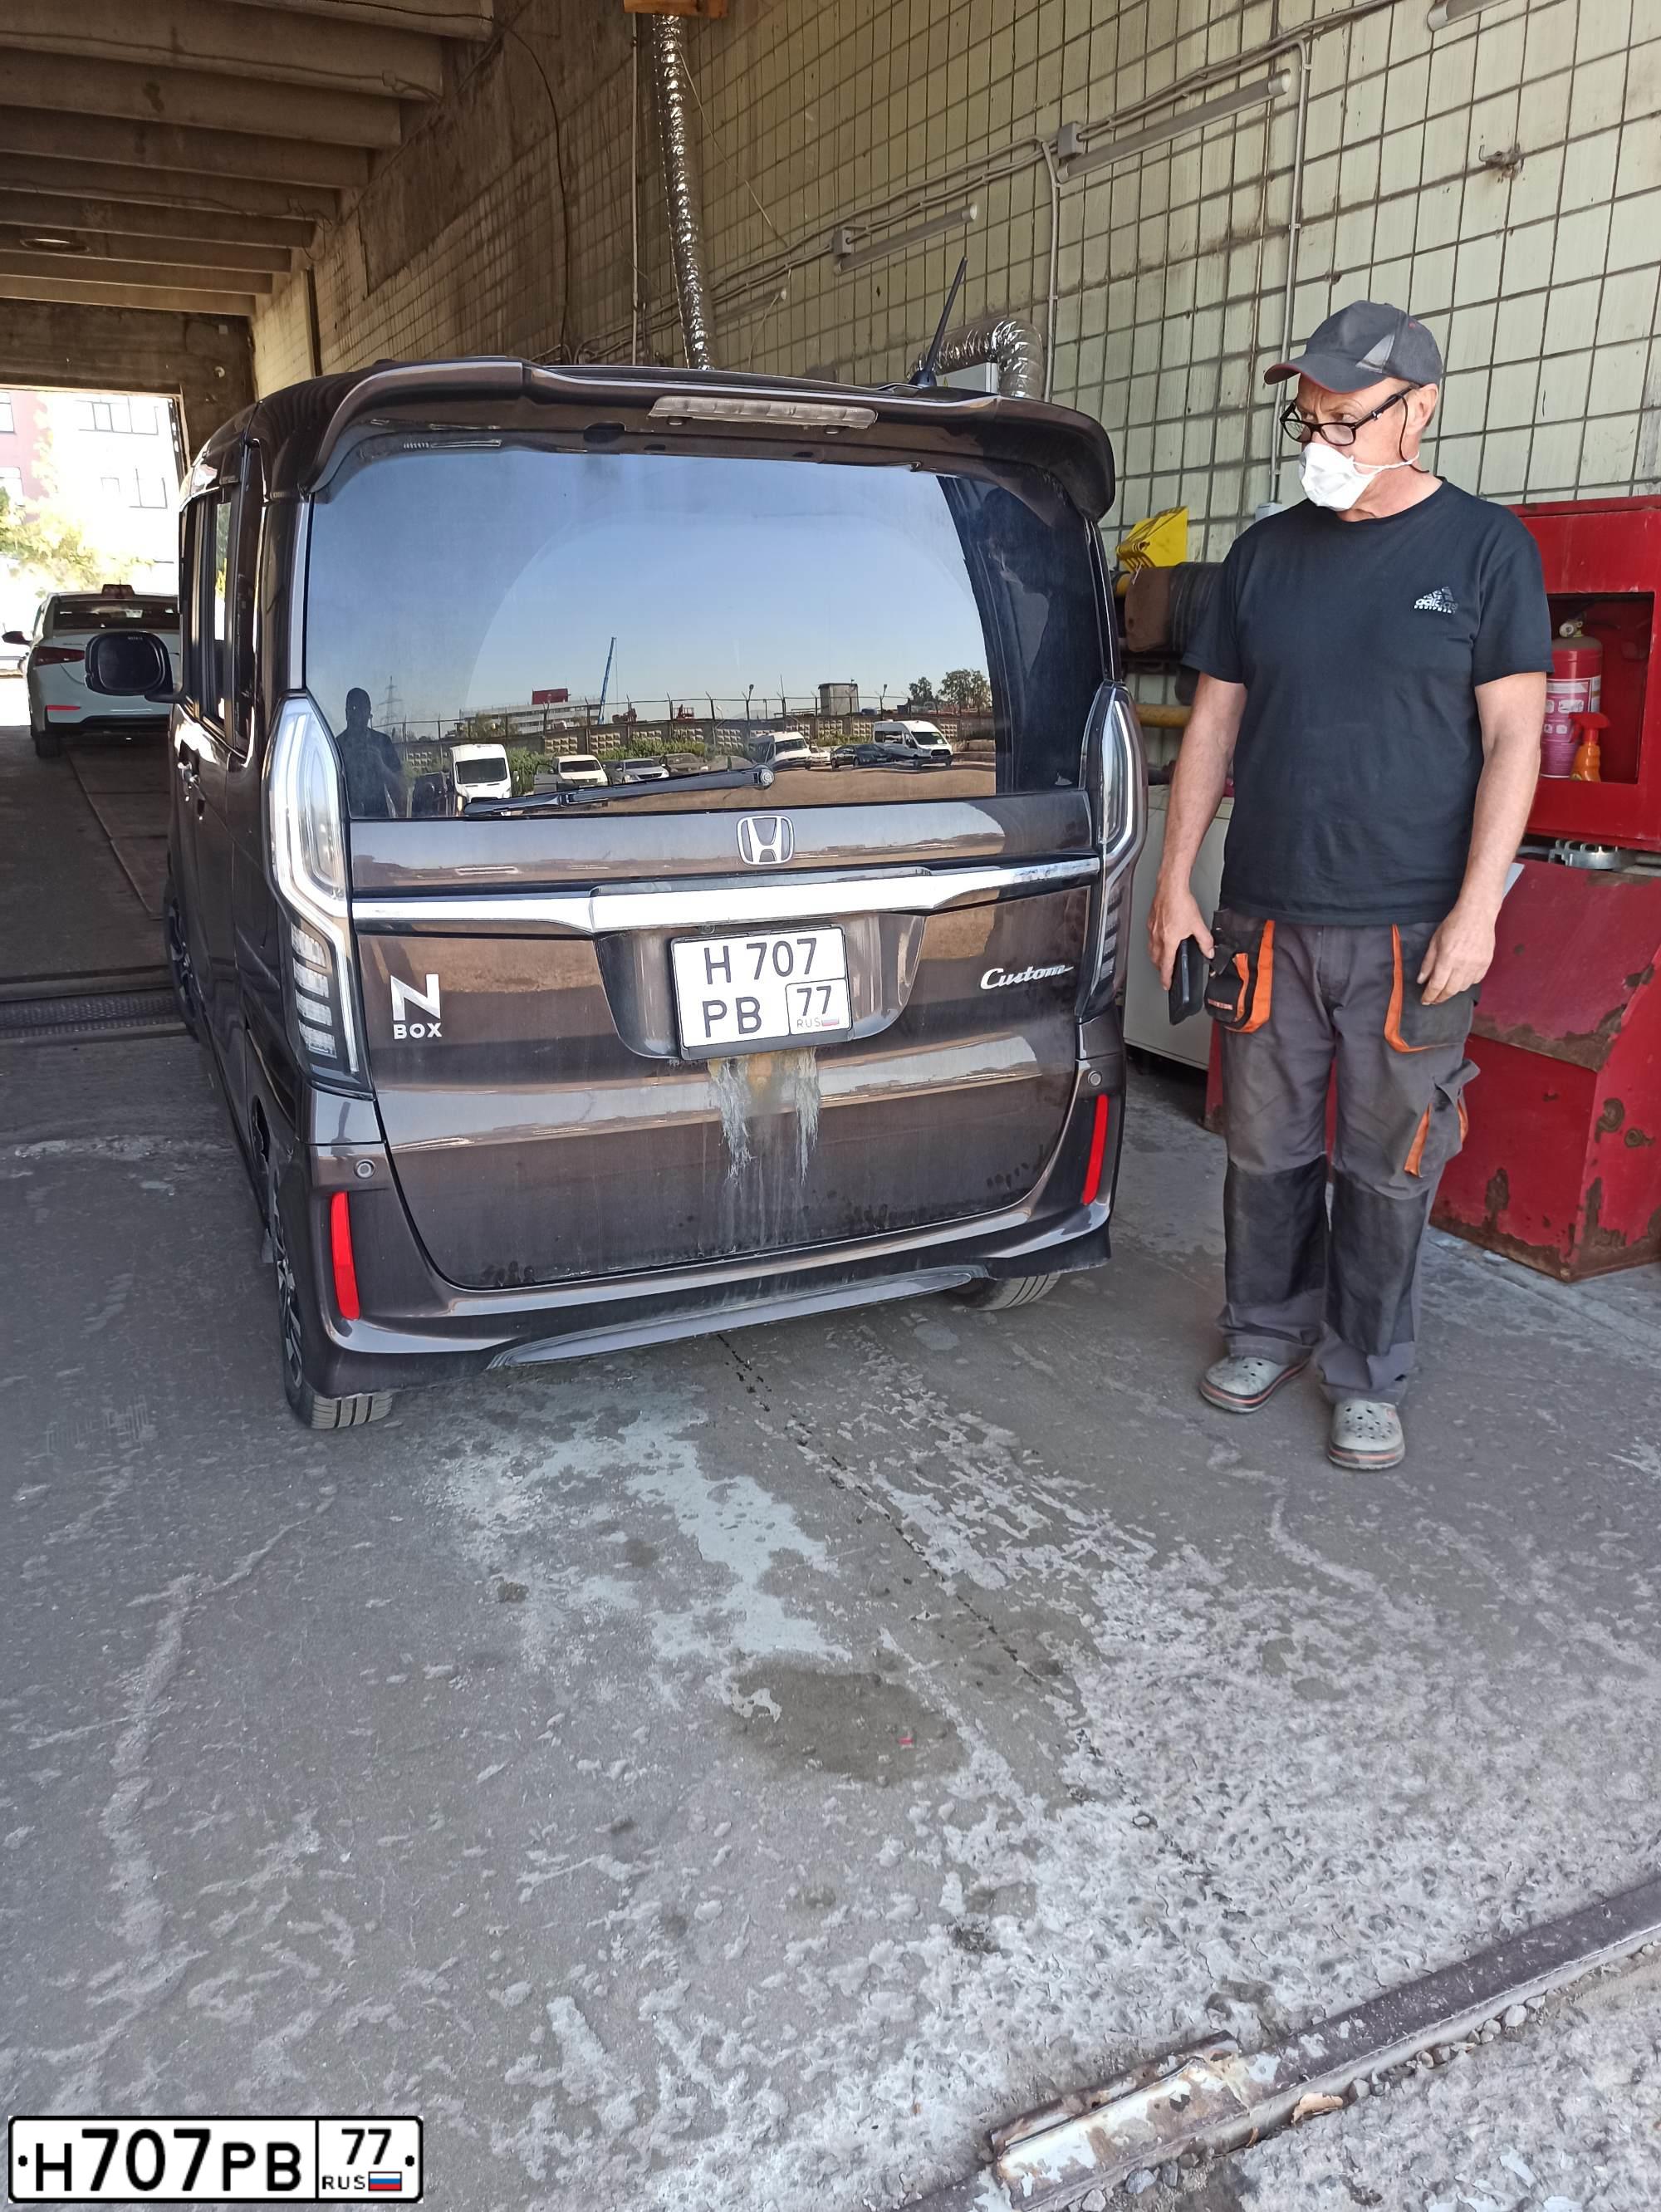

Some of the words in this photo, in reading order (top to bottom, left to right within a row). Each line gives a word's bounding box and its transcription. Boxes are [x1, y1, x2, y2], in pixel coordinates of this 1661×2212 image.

[1415, 598, 1459, 611] adidas
[747, 938, 816, 980] 707
[980, 964, 1075, 990] Custom
[390, 974, 441, 1021] N
[796, 985, 832, 1016] 77
[393, 1022, 443, 1040] BOX
[796, 1017, 821, 1028] RUS
